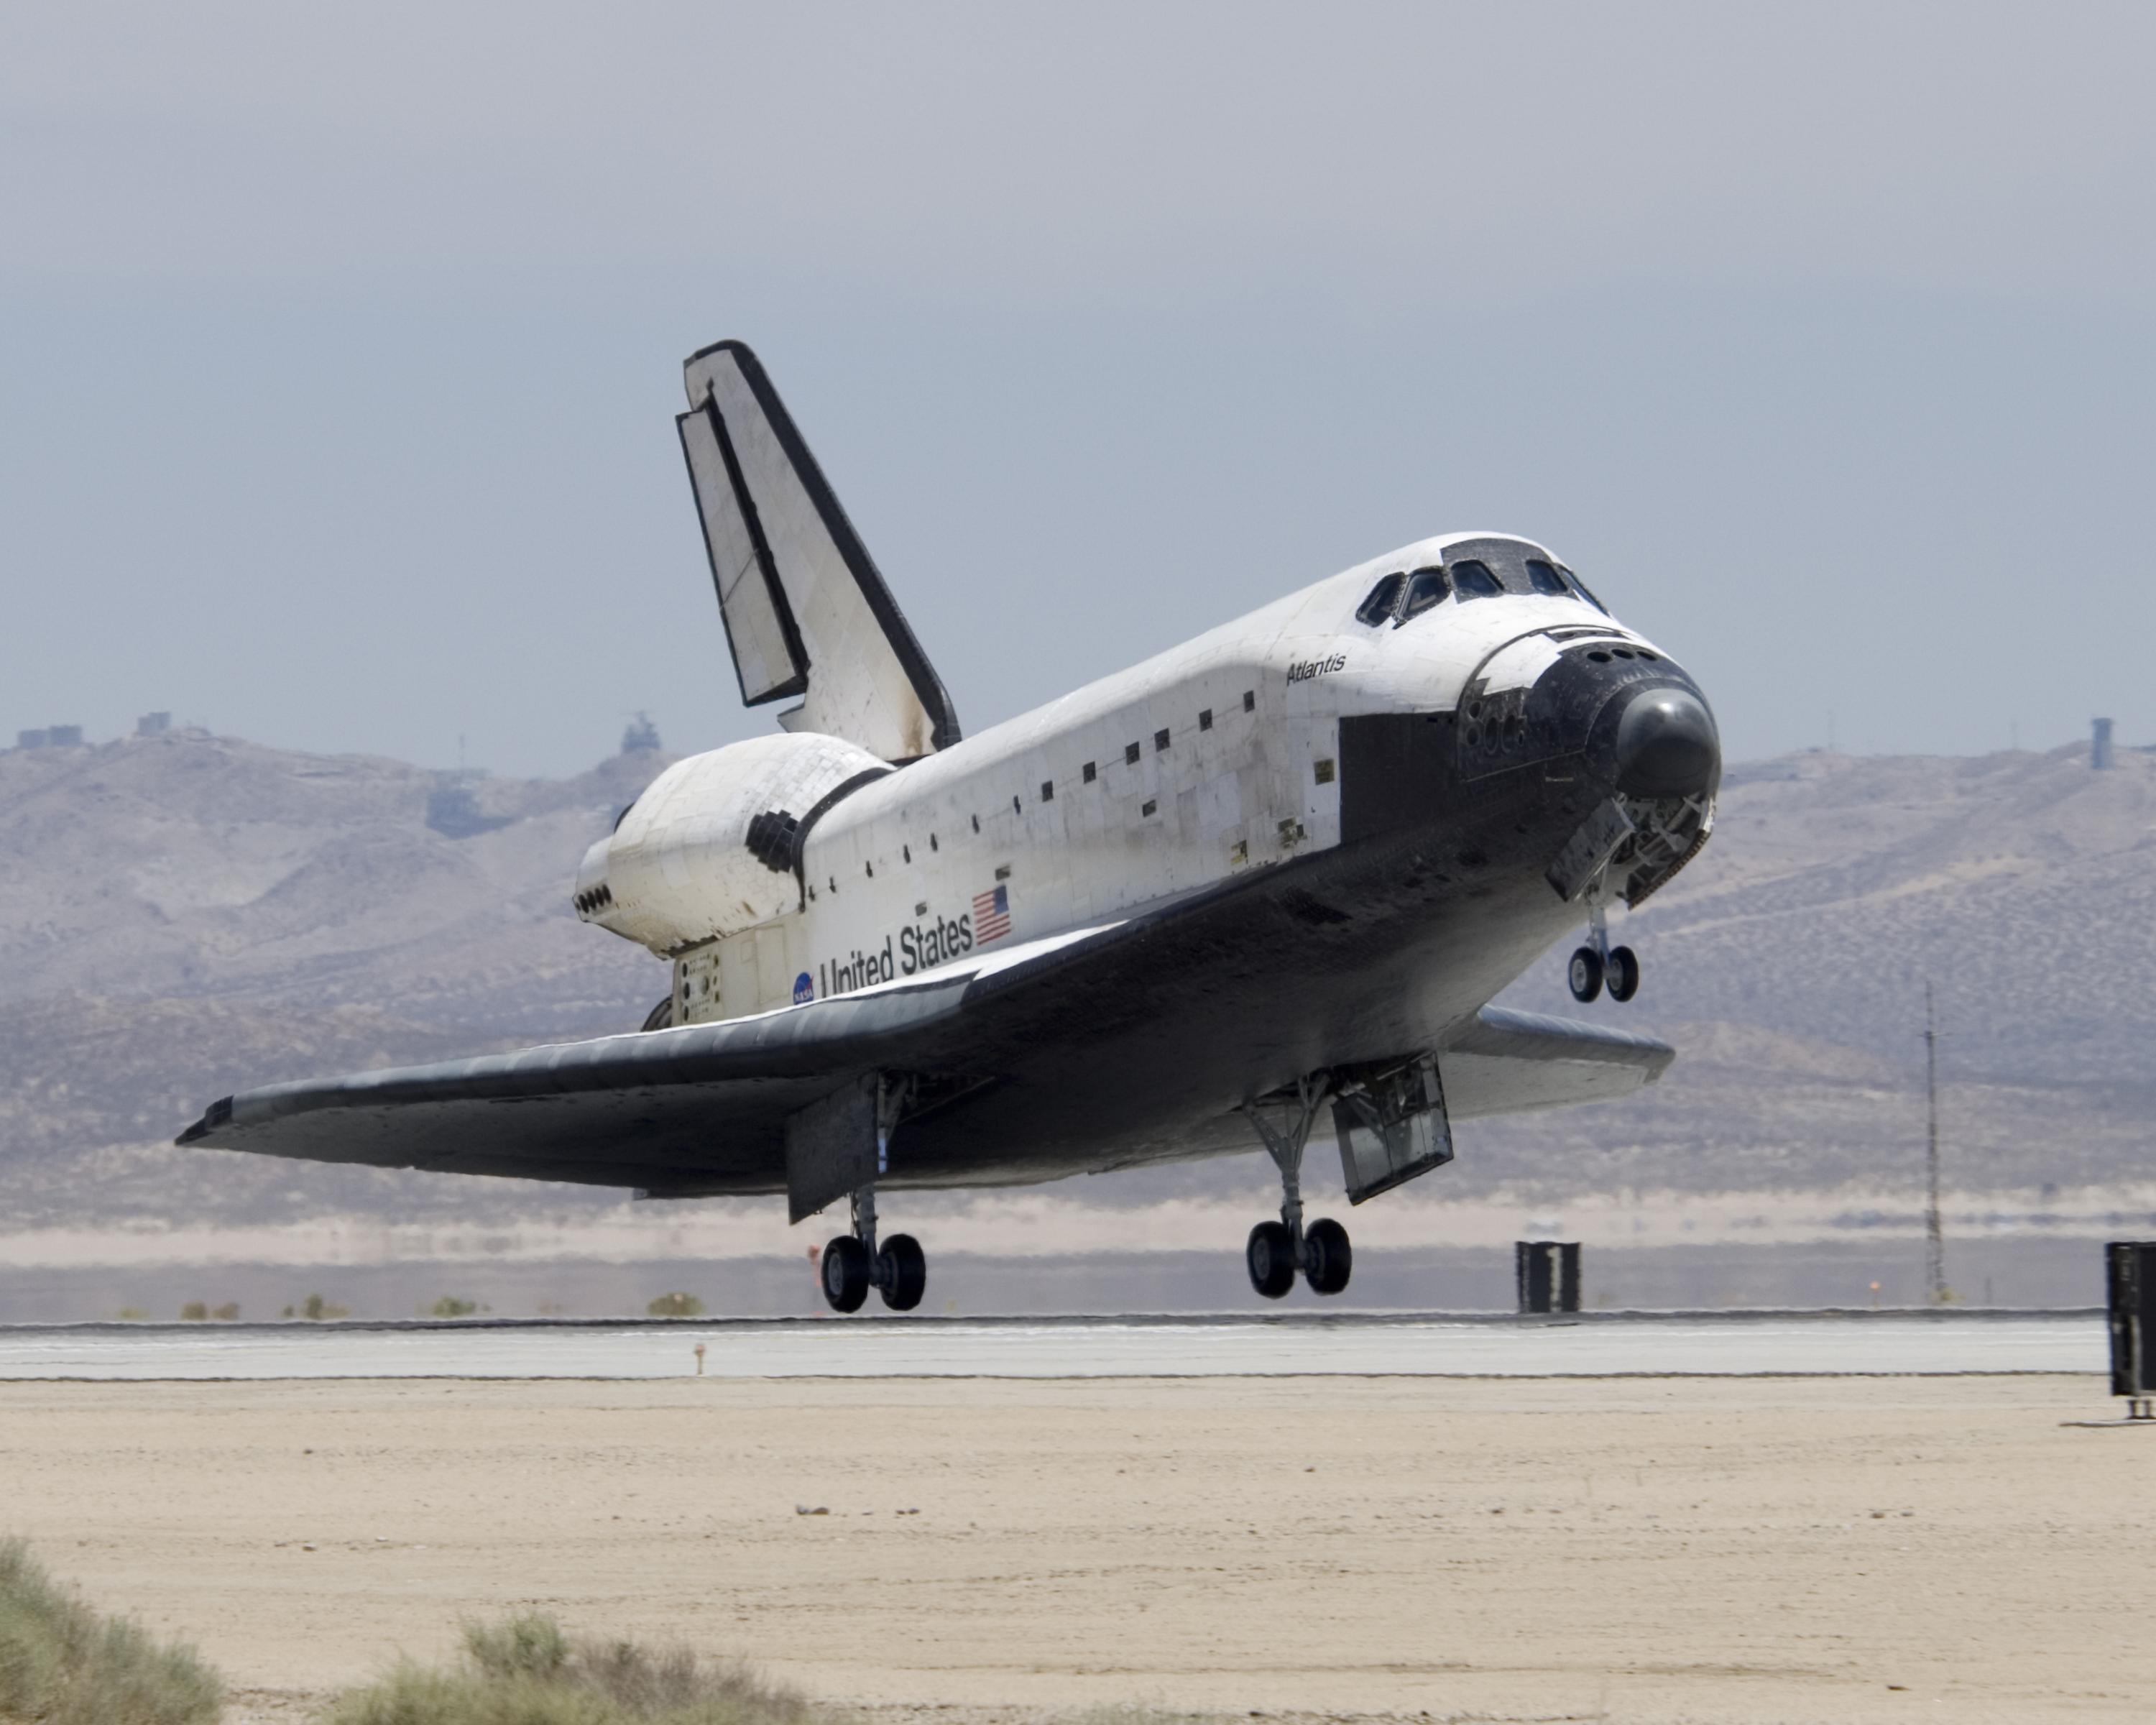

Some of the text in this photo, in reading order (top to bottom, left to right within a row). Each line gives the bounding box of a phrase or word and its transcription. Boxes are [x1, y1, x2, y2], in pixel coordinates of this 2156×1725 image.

[1287, 653, 1346, 686] Atlantis
[821, 914, 972, 998] United States
[794, 989, 813, 1002] NASA
[1546, 1246, 1562, 1302] 1
